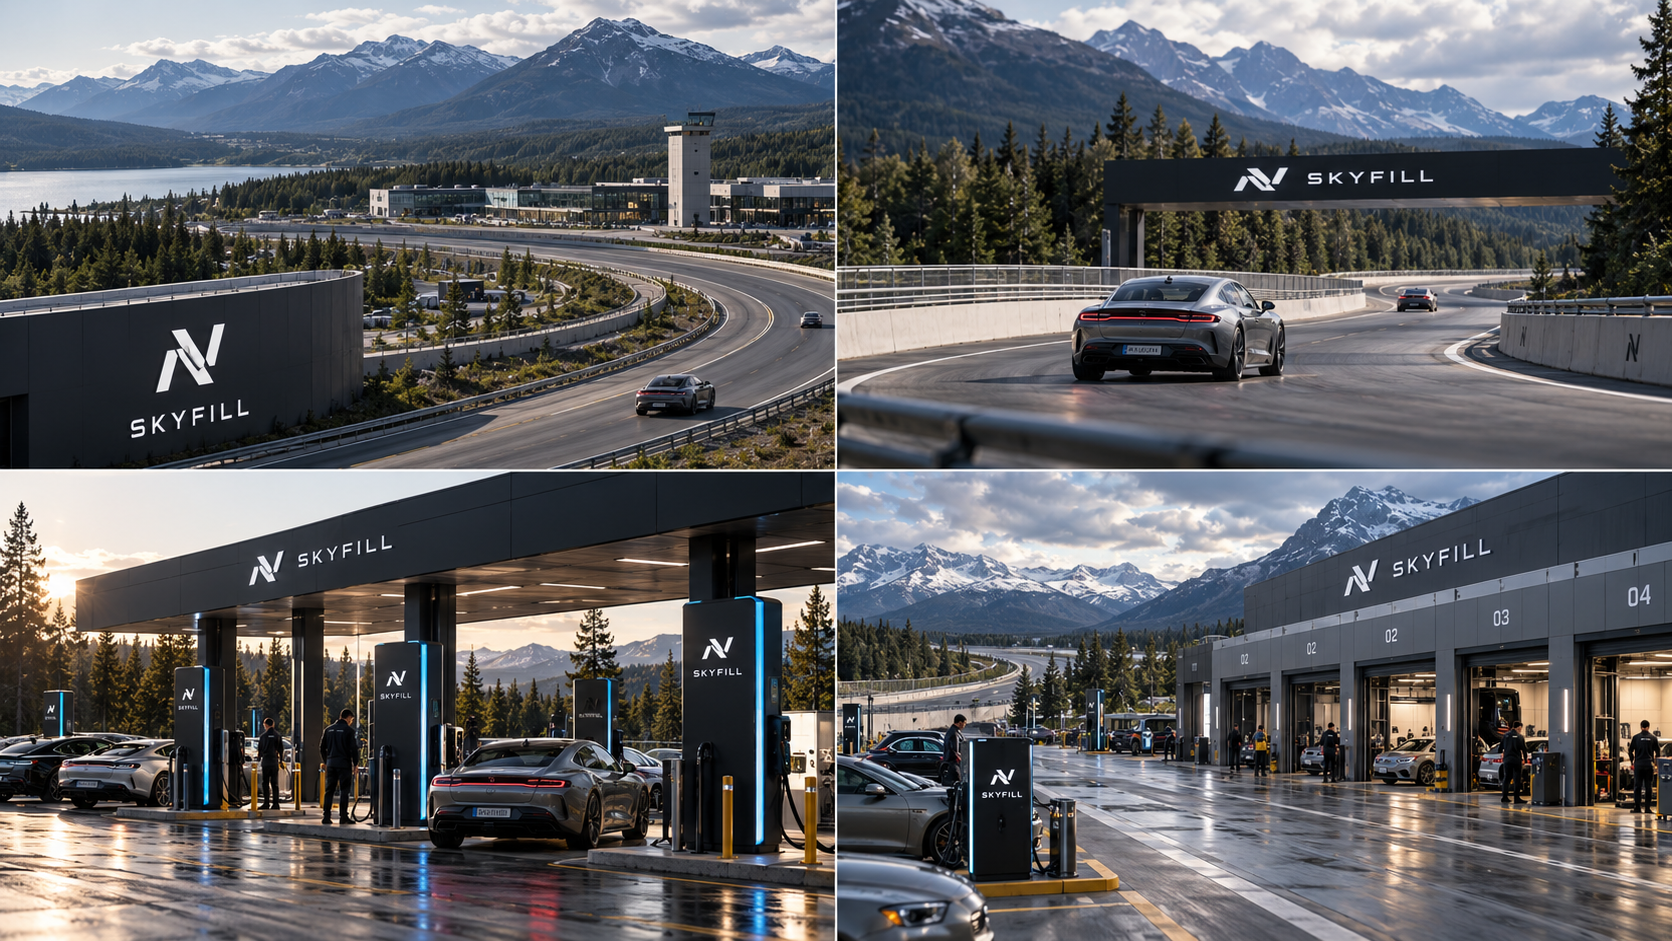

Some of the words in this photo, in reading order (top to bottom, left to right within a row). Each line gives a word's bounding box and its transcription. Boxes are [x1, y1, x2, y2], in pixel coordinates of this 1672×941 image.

[1307, 169, 1434, 185] SKYFILL
[130, 399, 250, 439] SKYFILL
[297, 535, 393, 568] SKYFILL
[1392, 538, 1492, 577] SKYFILL
[1627, 584, 1652, 607] 04
[1493, 608, 1510, 627] 03
[1385, 627, 1398, 644] 02
[1306, 641, 1317, 655] 02
[1240, 653, 1249, 665] 02
[693, 667, 743, 679] SKYFILL
[380, 692, 412, 700] SKYFILL
[981, 791, 1023, 799] SKYFILL
